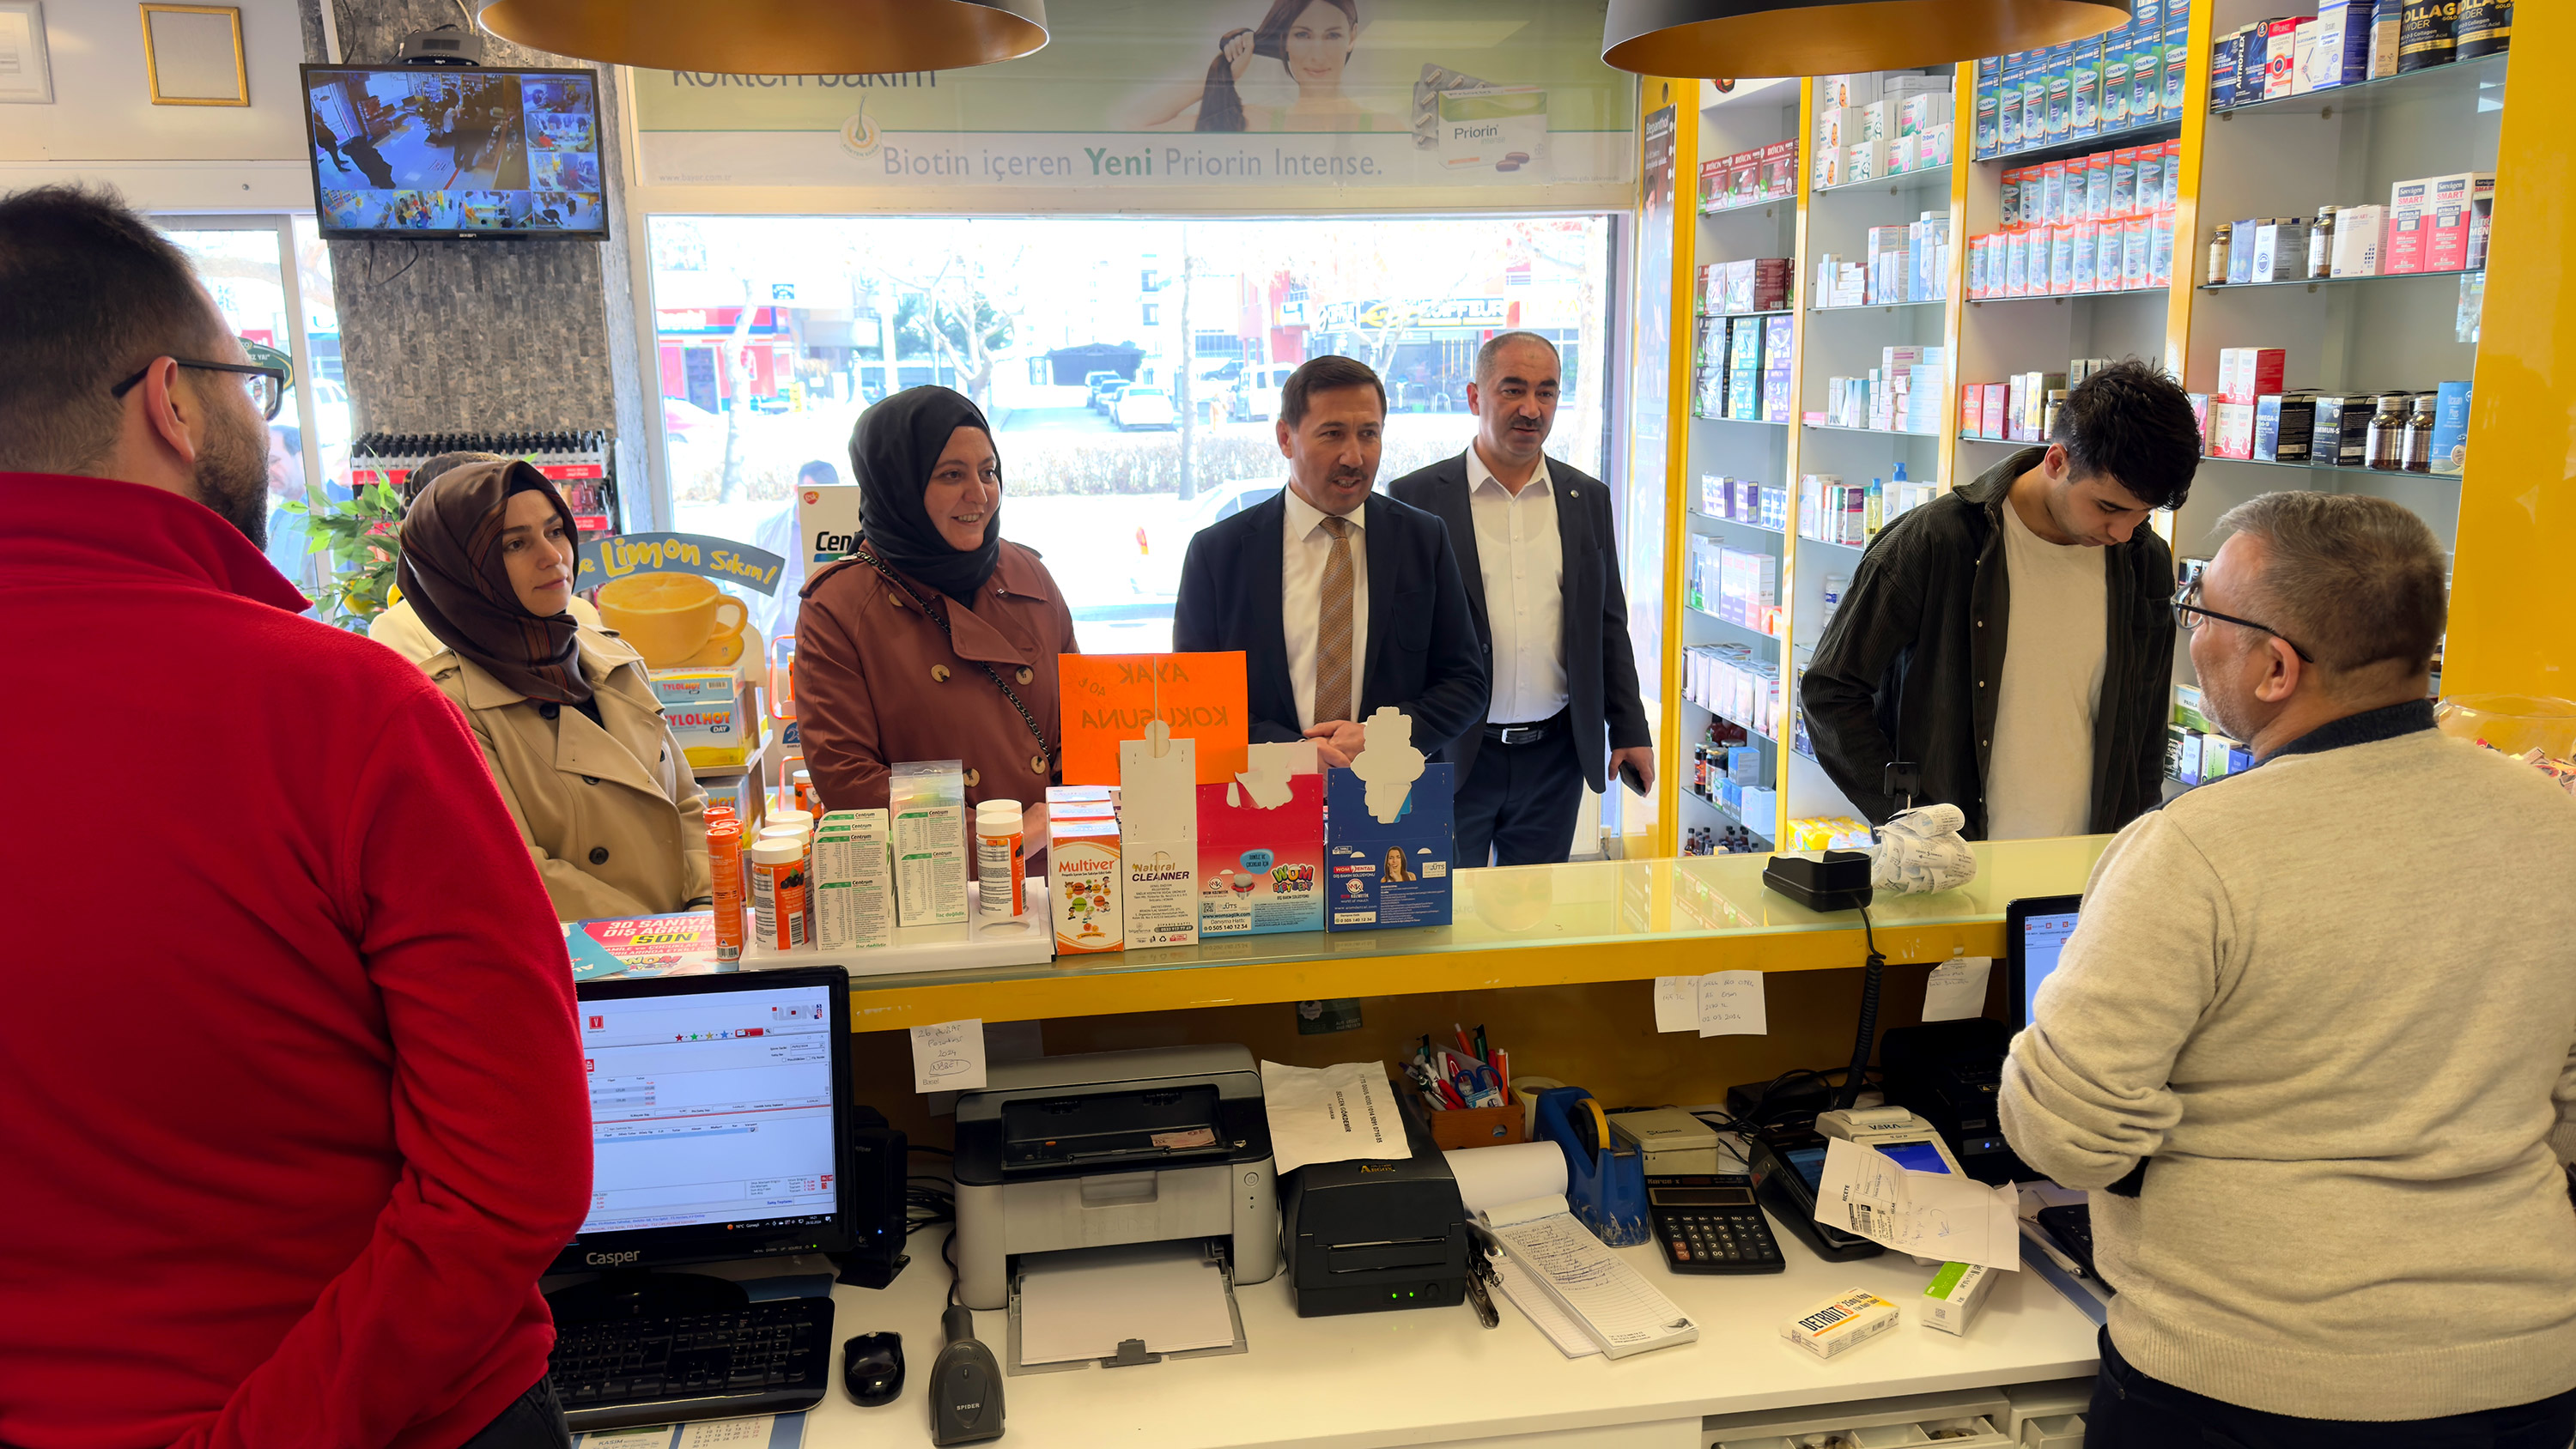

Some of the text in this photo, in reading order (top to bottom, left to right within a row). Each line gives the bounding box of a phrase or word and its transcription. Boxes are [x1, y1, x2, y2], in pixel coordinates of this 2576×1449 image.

[1454, 125, 1498, 141] Priorin
[1480, 136, 1506, 145] intense
[884, 147, 1382, 182] Biotin içeren Yeni Priorin Intense.
[2397, 196, 2424, 205] SMART
[2437, 191, 2464, 200] SMART
[2470, 227, 2488, 236] MEN
[600, 537, 701, 578] Limon
[709, 549, 778, 585] Sıkın!
[708, 797, 736, 807] HOT
[1059, 858, 1115, 873] Multiver
[1134, 863, 1176, 872] Natural
[1132, 871, 1190, 882] CLEANNER
[1272, 865, 1314, 883] WOM
[1273, 882, 1292, 894] BABY
[636, 933, 694, 943] SON
[917, 1029, 931, 1038] 26
[586, 1250, 641, 1267] Casper
